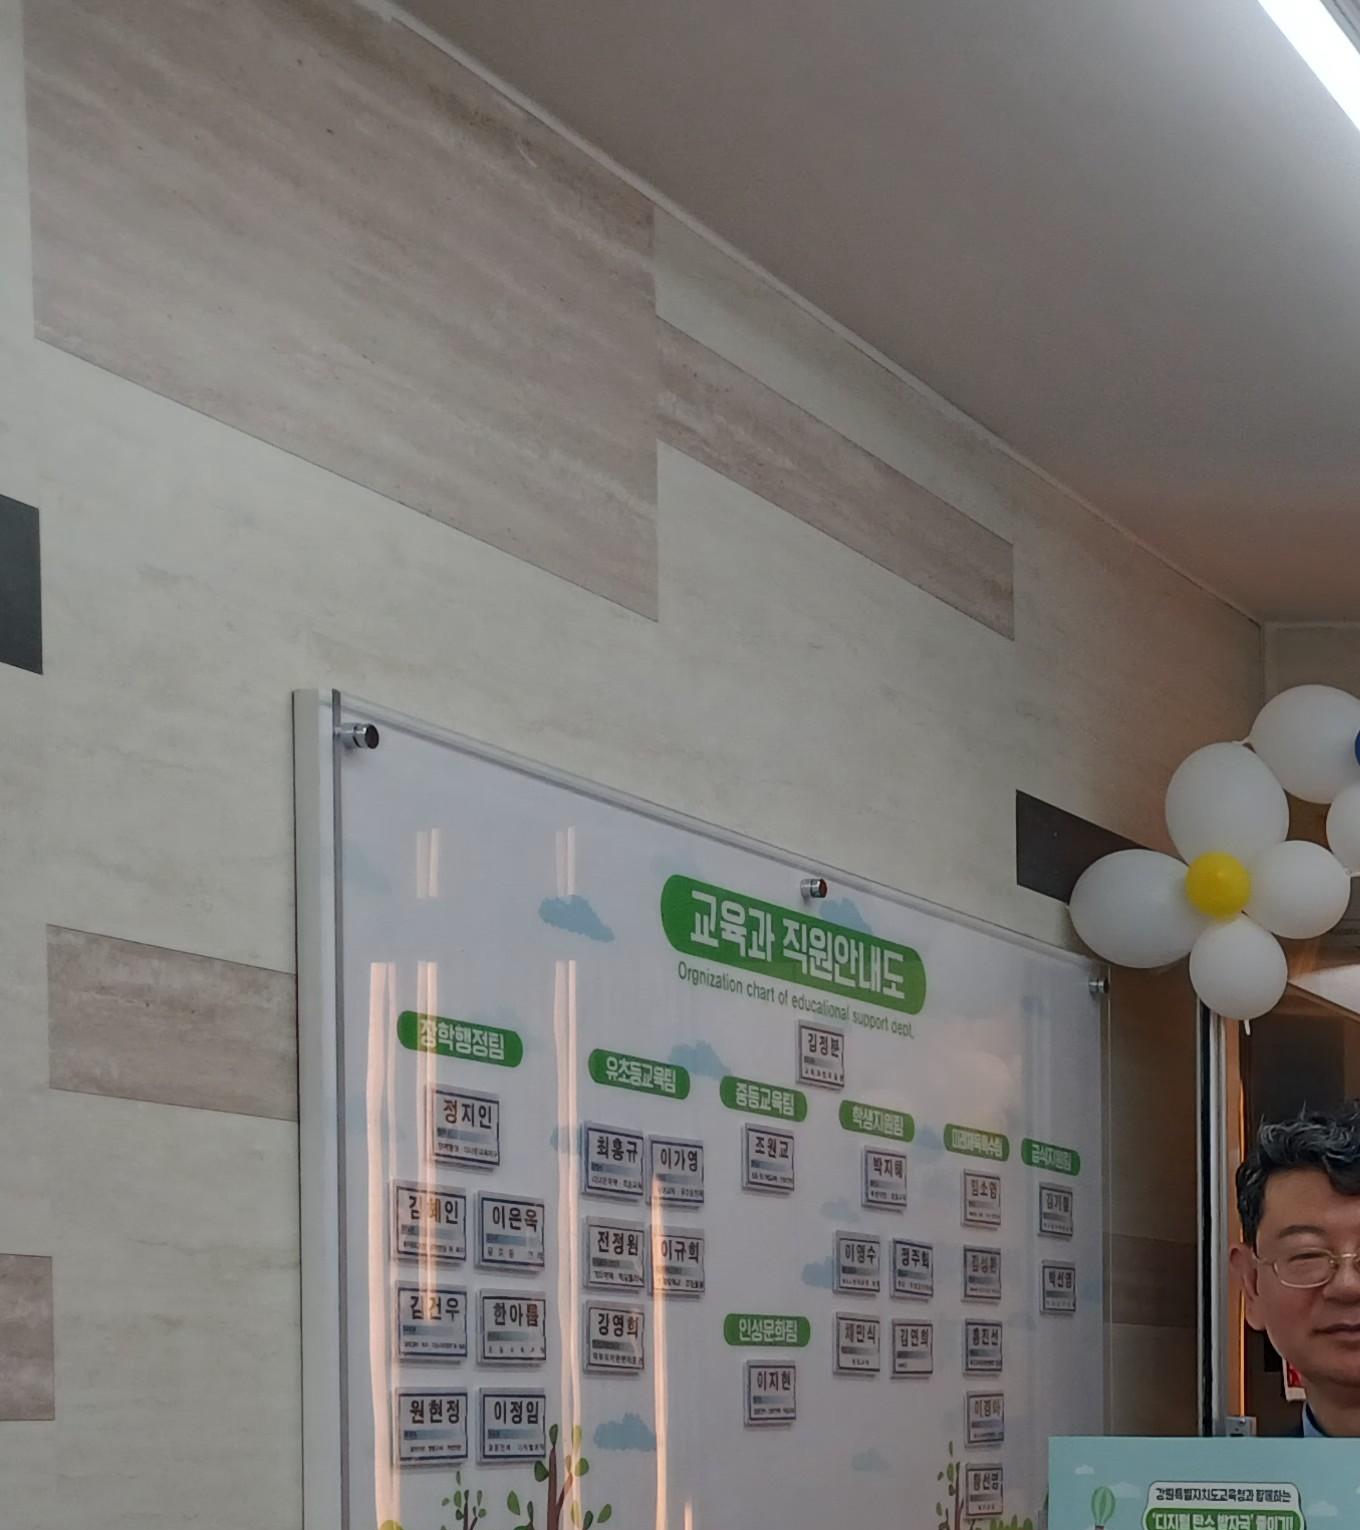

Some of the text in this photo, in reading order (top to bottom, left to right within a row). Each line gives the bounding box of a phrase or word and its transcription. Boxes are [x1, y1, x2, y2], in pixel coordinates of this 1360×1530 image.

[690, 890, 904, 999] 교육과 직원안내도
[678, 961, 742, 994] Orgnization
[747, 982, 775, 1002] chart
[778, 990, 789, 1006] of
[792, 993, 849, 1021] educational
[852, 1011, 888, 1032] support
[419, 1019, 504, 1060] 장학행정팀
[606, 1057, 676, 1094] 유초등교육팀
[443, 1099, 492, 1129] 정지인
[736, 1082, 794, 1117] 중등교육팀
[660, 1148, 698, 1172] 이가영
[493, 1302, 539, 1327] 한아름
[739, 1318, 798, 1343] 인성문화팀
[410, 1399, 460, 1425] 원현정
[494, 1400, 539, 1425] 이정임
